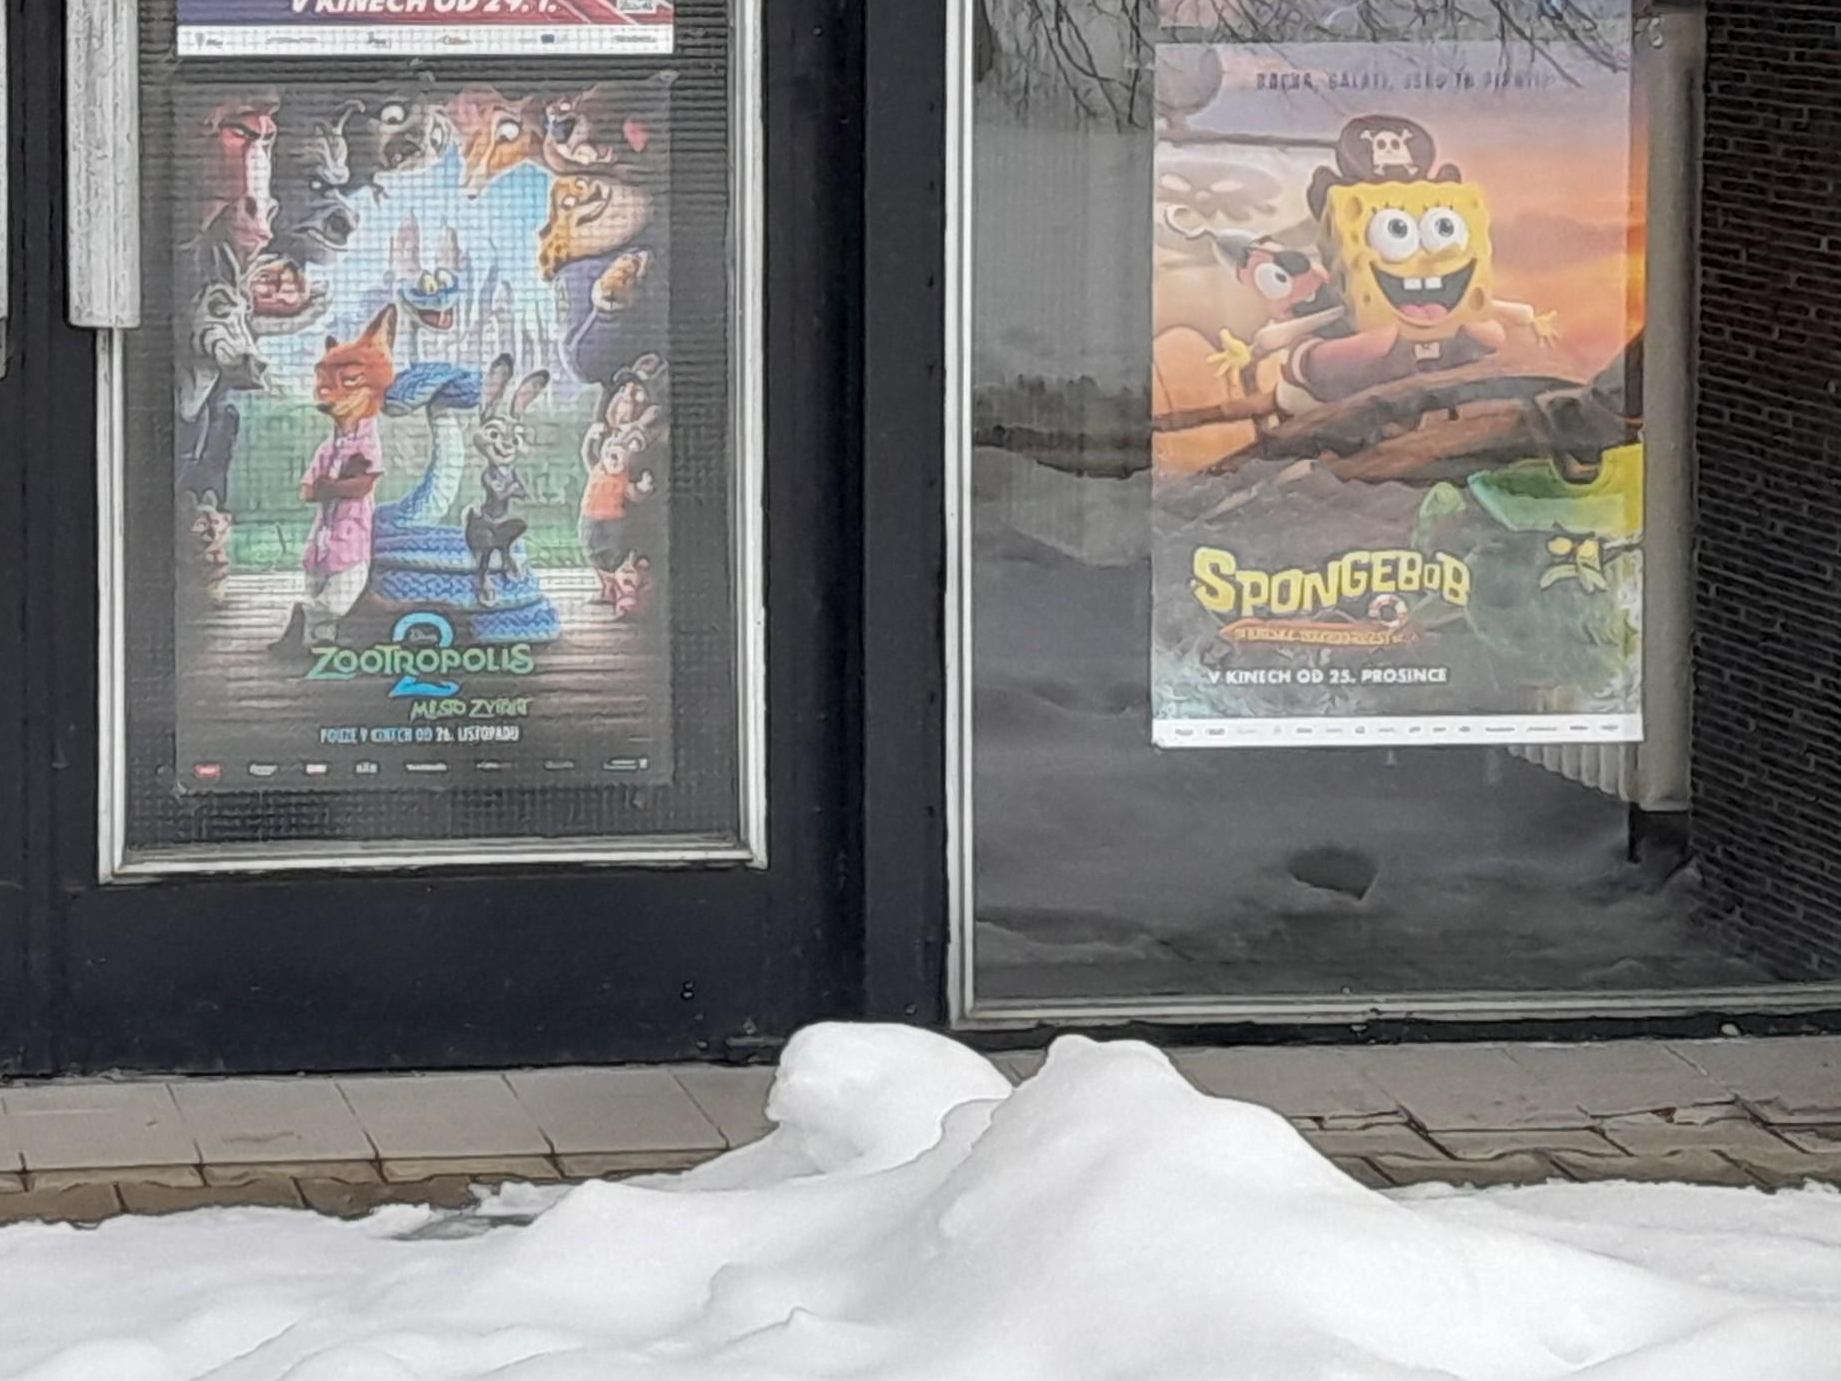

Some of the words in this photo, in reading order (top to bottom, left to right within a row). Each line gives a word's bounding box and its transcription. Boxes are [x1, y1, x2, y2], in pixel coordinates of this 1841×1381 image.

[1192, 546, 1472, 617] SPONGEBOB
[306, 643, 537, 680] ZOOTROPOLIS
[388, 611, 461, 698] 2
[1209, 670, 1221, 685] V
[1225, 669, 1292, 685] KINECH
[1296, 669, 1324, 684] OD
[1329, 669, 1356, 684] 25.
[1360, 667, 1449, 683] PROSINCE
[458, 725, 520, 742] LISTOPADU
